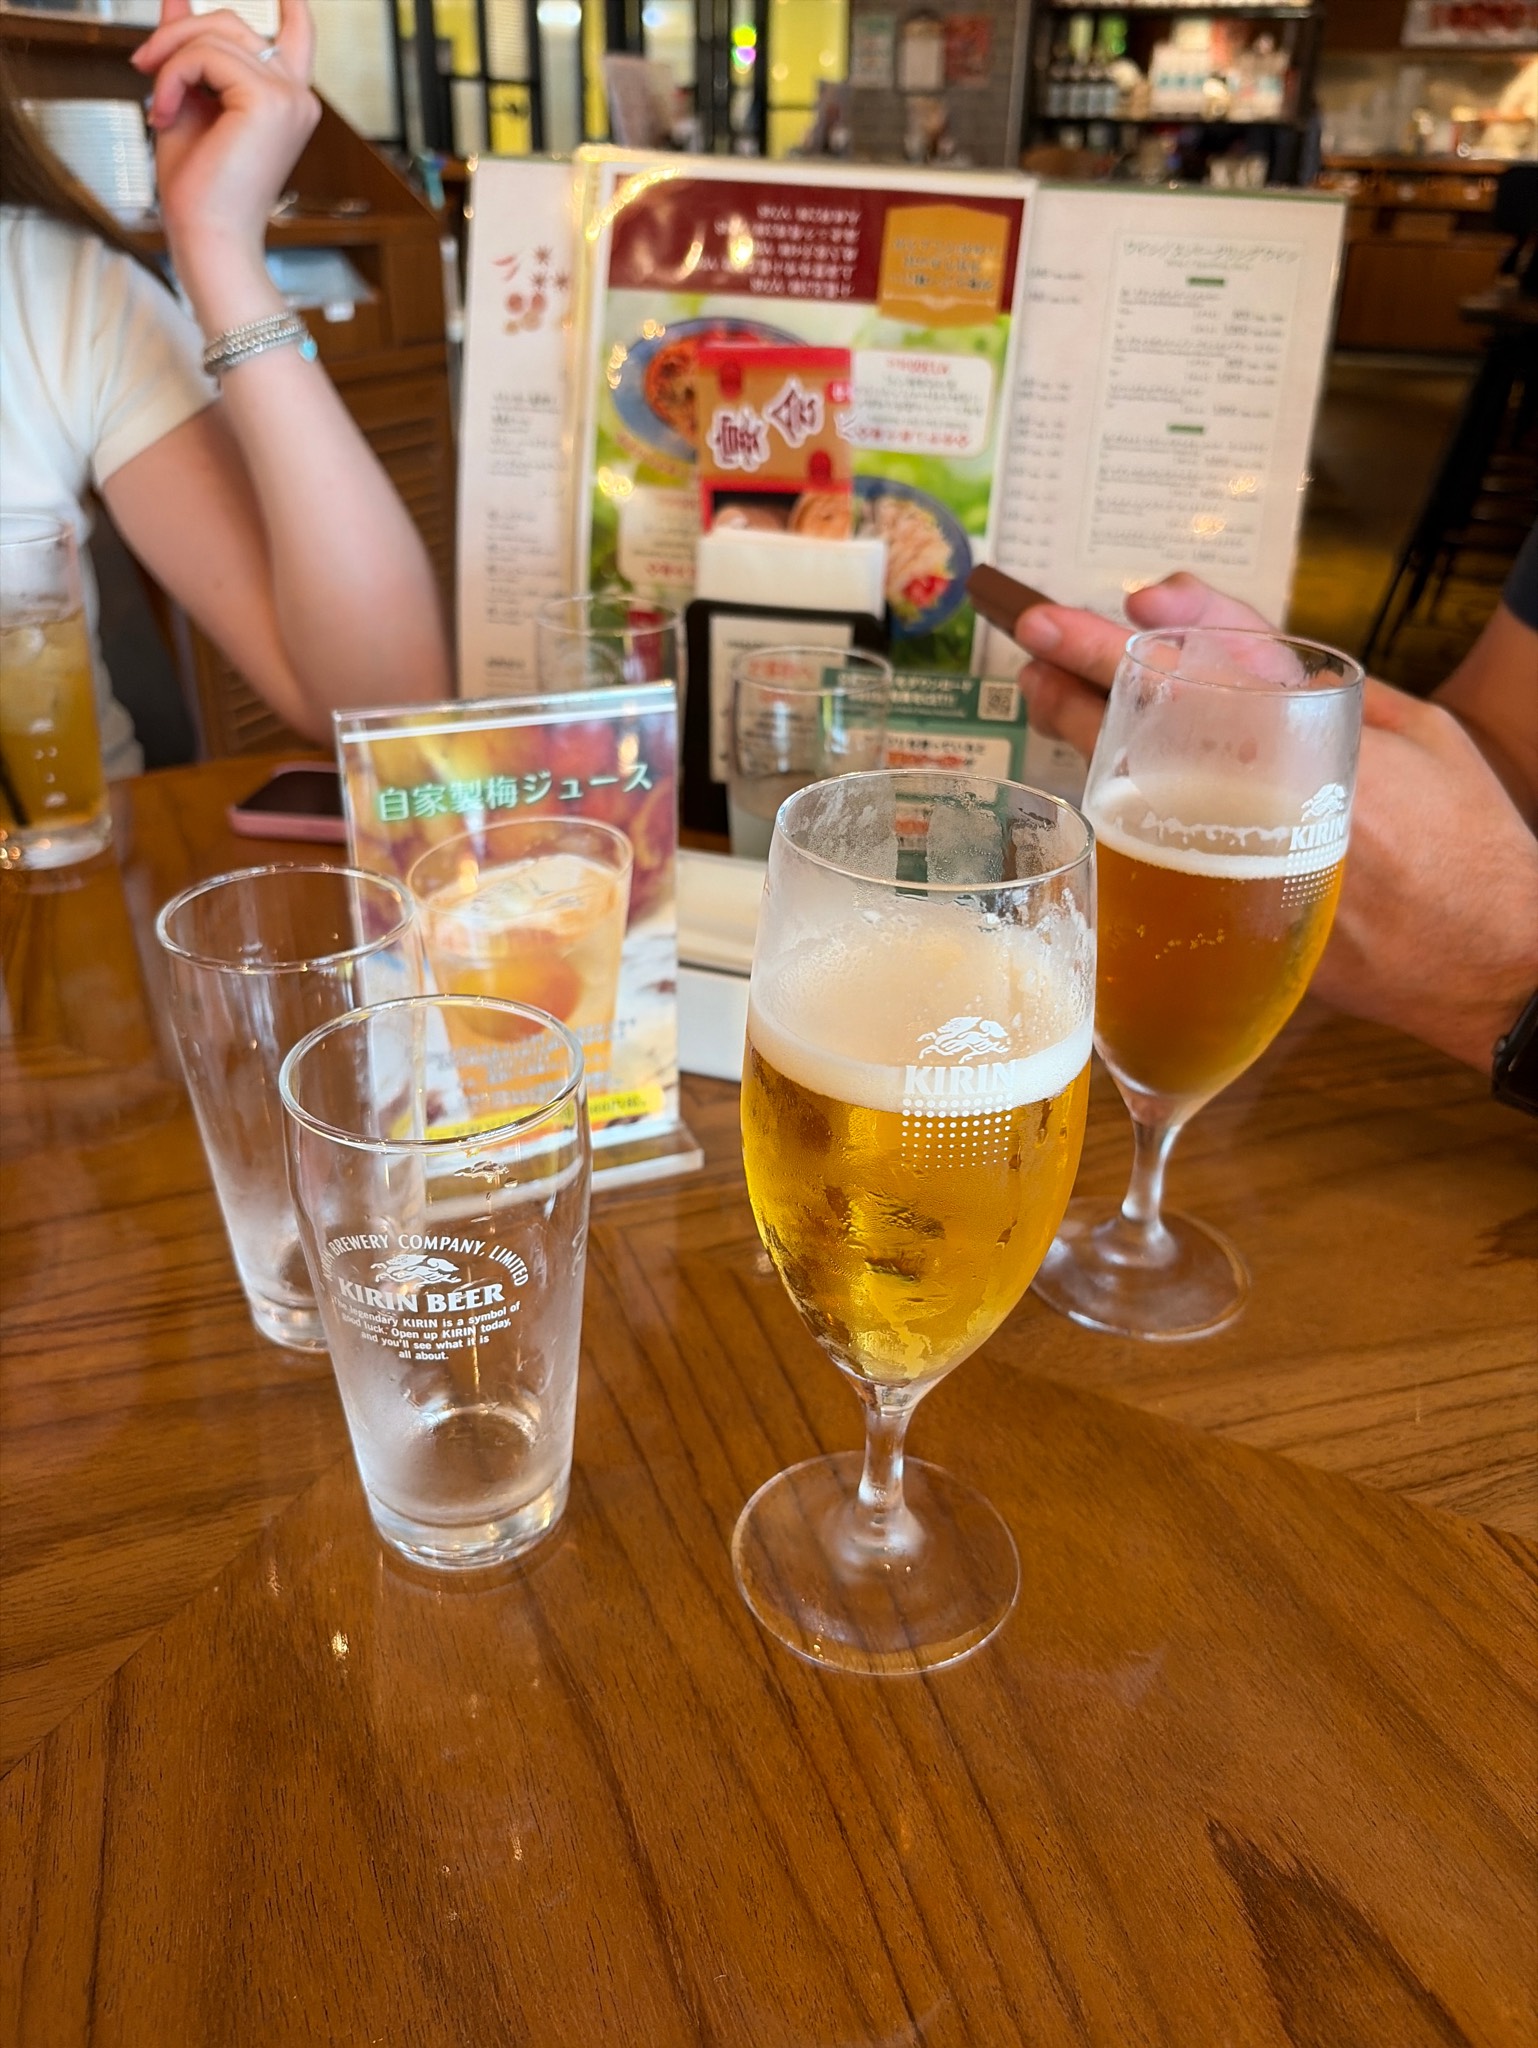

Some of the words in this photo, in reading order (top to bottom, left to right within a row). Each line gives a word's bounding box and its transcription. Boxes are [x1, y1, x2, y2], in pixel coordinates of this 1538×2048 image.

[379, 763, 652, 821] 自家製梅ジュース
[1289, 814, 1346, 851] KIRIN
[904, 1061, 1017, 1095] KIRIN
[328, 1234, 389, 1256] BREWERY
[398, 1234, 486, 1256] COMPANY,
[488, 1245, 529, 1287] LIMITED
[338, 1277, 418, 1312] KIRIN
[426, 1283, 505, 1313] BEER
[350, 1305, 399, 1327] legendary
[403, 1318, 438, 1328] KIRIN
[443, 1318, 453, 1327] is
[457, 1318, 464, 1326] a
[468, 1306, 507, 1325] symbol
[510, 1300, 521, 1312] of
[364, 1321, 388, 1335] luck.
[391, 1327, 419, 1339] Open
[423, 1331, 438, 1340] up
[442, 1326, 476, 1338] KIRIN
[361, 1331, 378, 1342] and
[381, 1338, 409, 1349] you'll
[413, 1341, 432, 1350] see
[436, 1339, 463, 1350] what
[467, 1338, 476, 1347] it
[479, 1335, 490, 1344] is
[398, 1350, 411, 1359] all
[415, 1350, 449, 1360] about.
